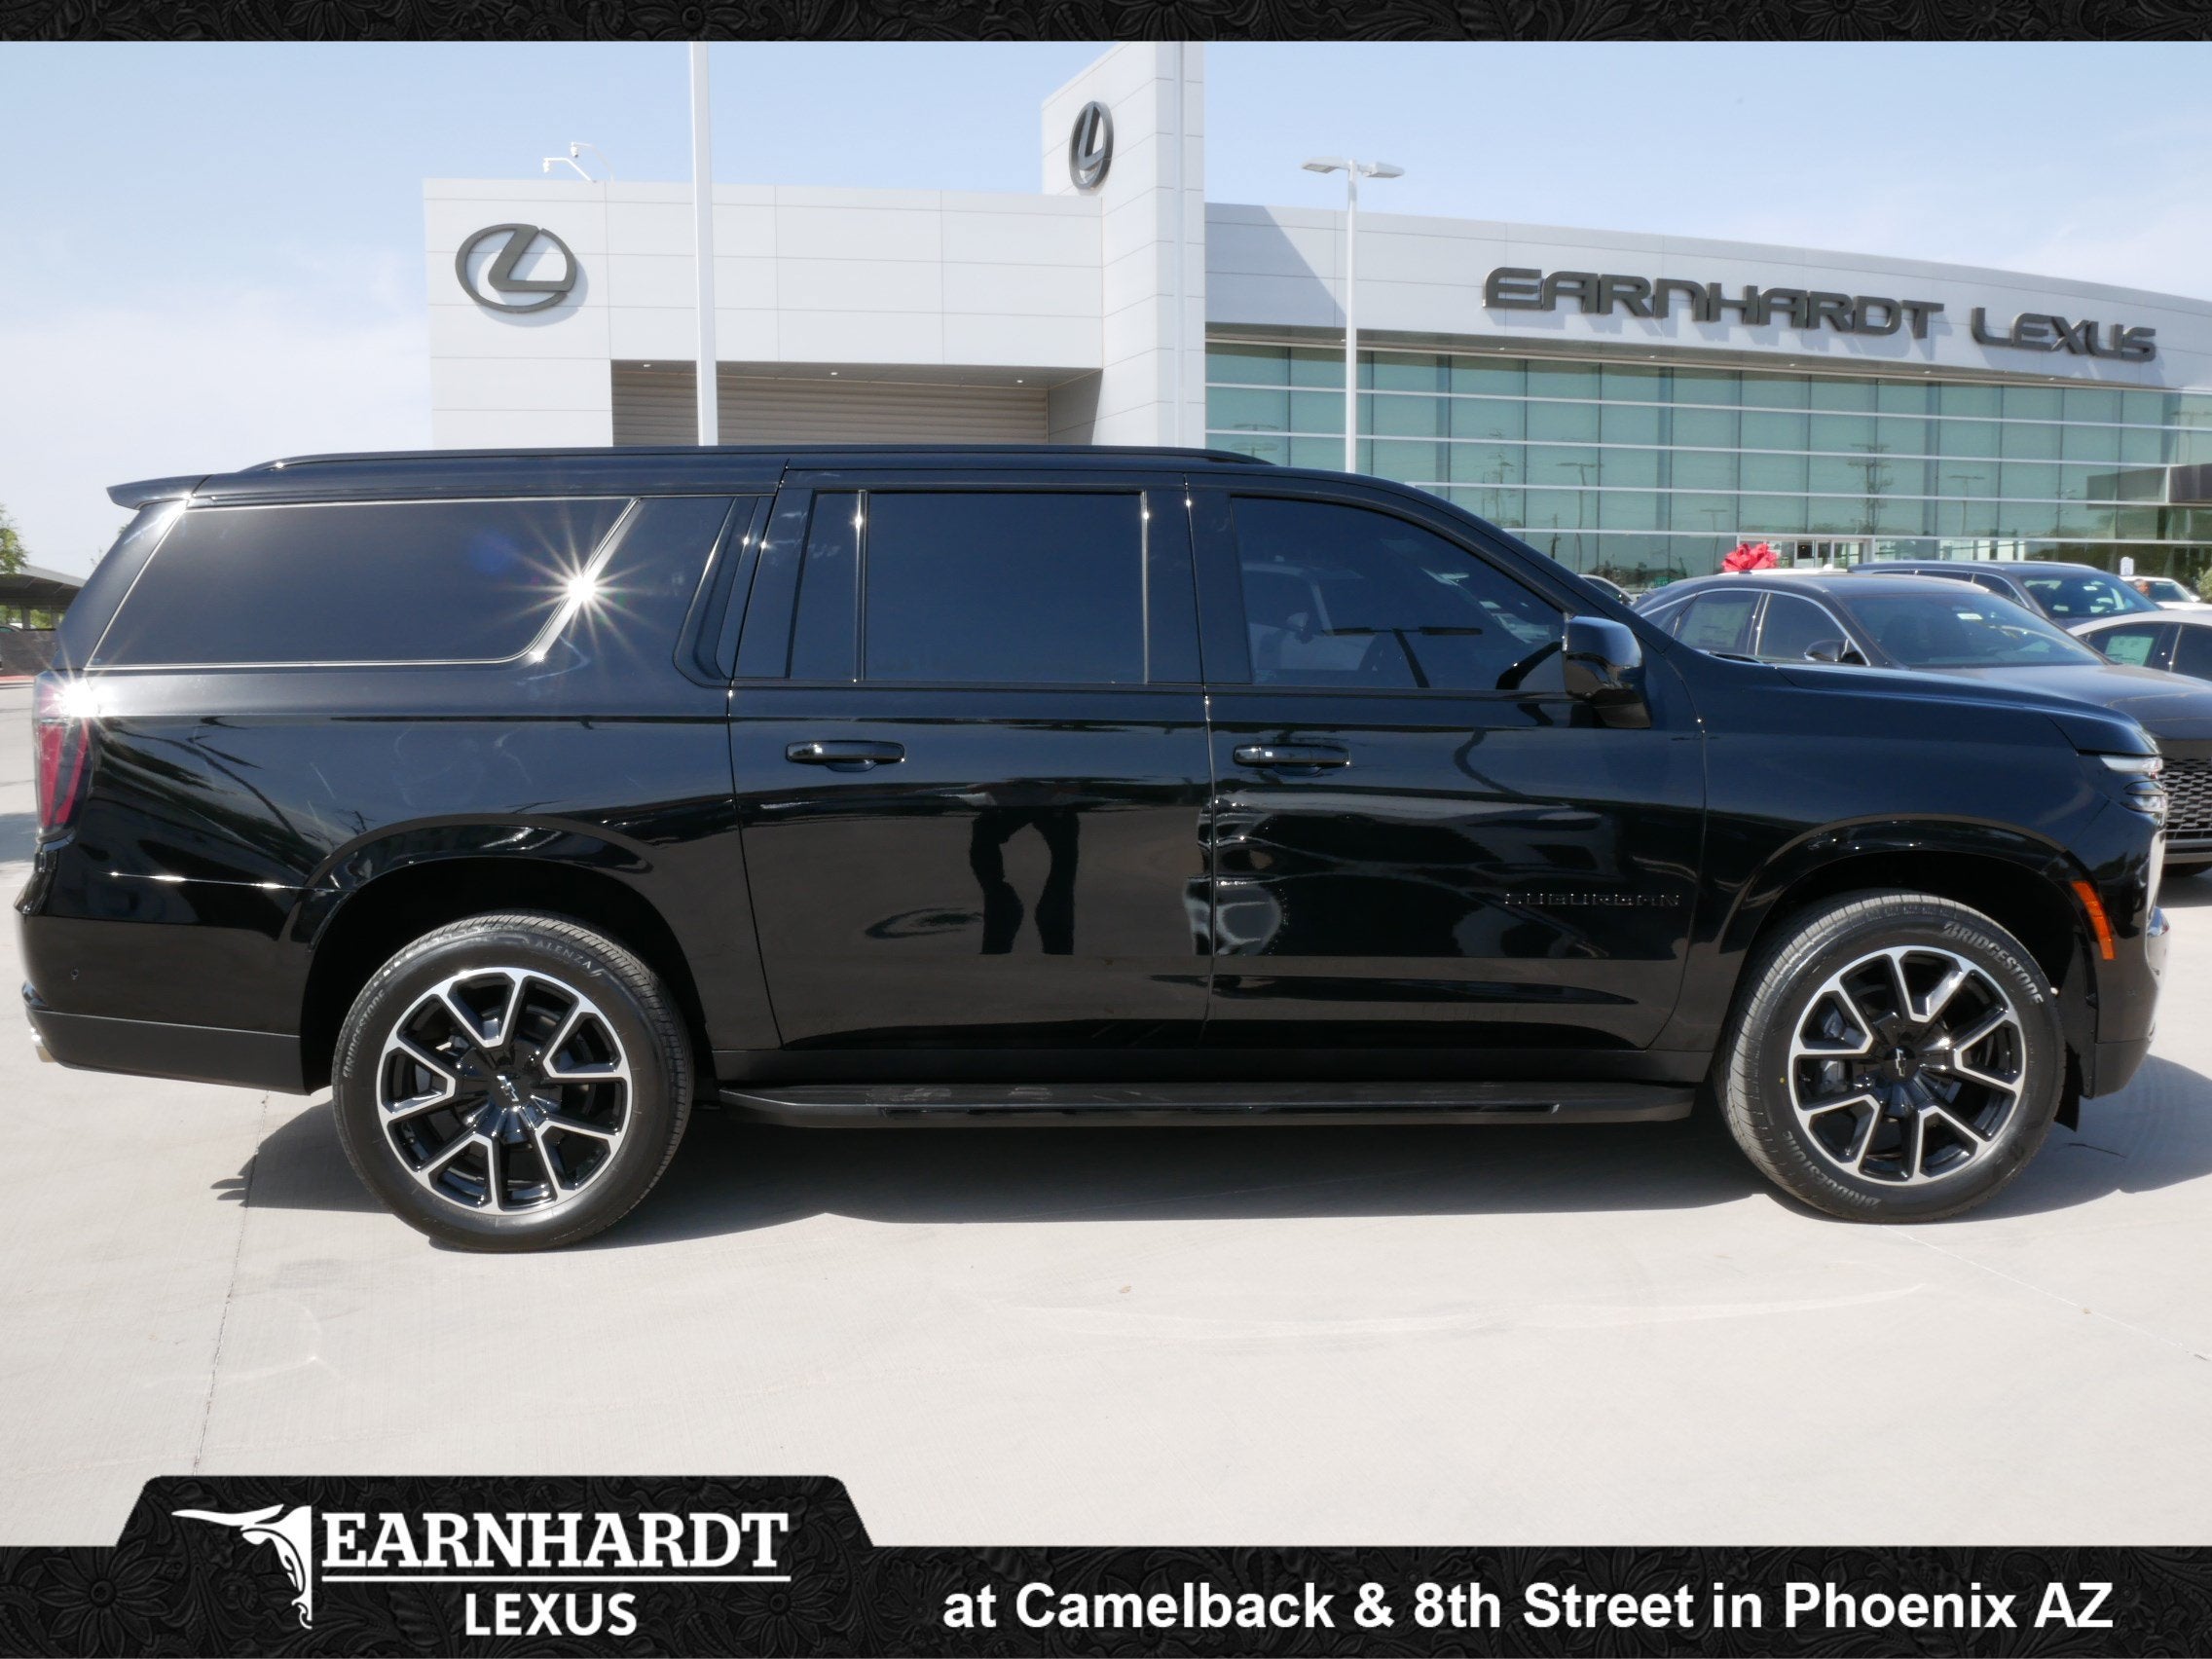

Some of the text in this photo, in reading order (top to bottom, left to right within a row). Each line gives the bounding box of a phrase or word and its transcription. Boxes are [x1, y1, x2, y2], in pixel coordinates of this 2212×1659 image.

[1483, 267, 2156, 362] EARNHARDT LEXUS
[1943, 921, 2044, 1004] BRIDGESTONE
